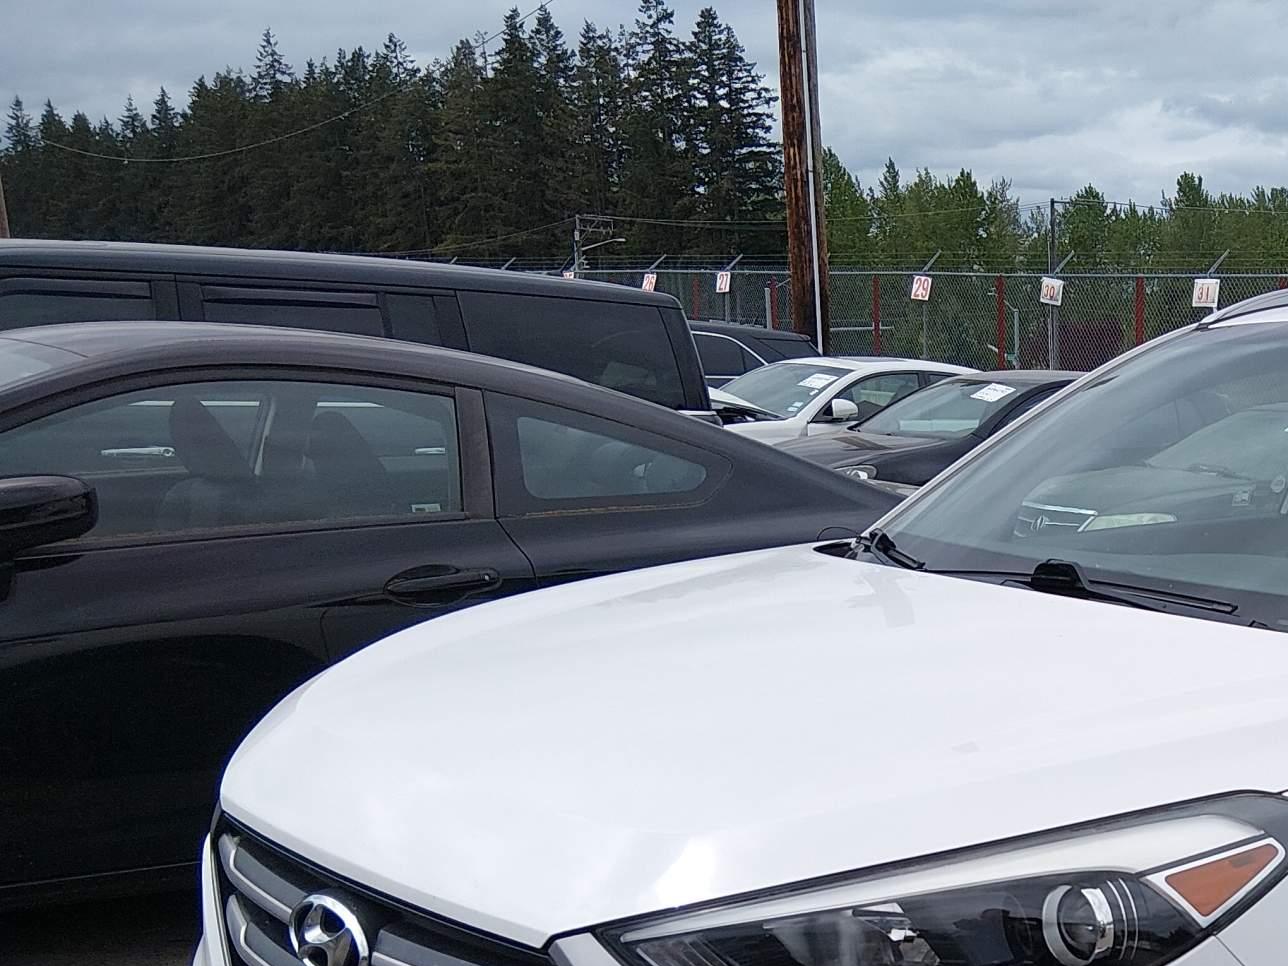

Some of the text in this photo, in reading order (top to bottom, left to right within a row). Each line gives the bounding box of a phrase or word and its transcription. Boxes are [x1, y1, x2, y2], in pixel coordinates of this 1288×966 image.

[643, 274, 657, 292] 26
[718, 272, 730, 292] 27
[912, 277, 930, 299] 29
[1043, 284, 1056, 299] 30
[1197, 286, 1210, 301] 31
